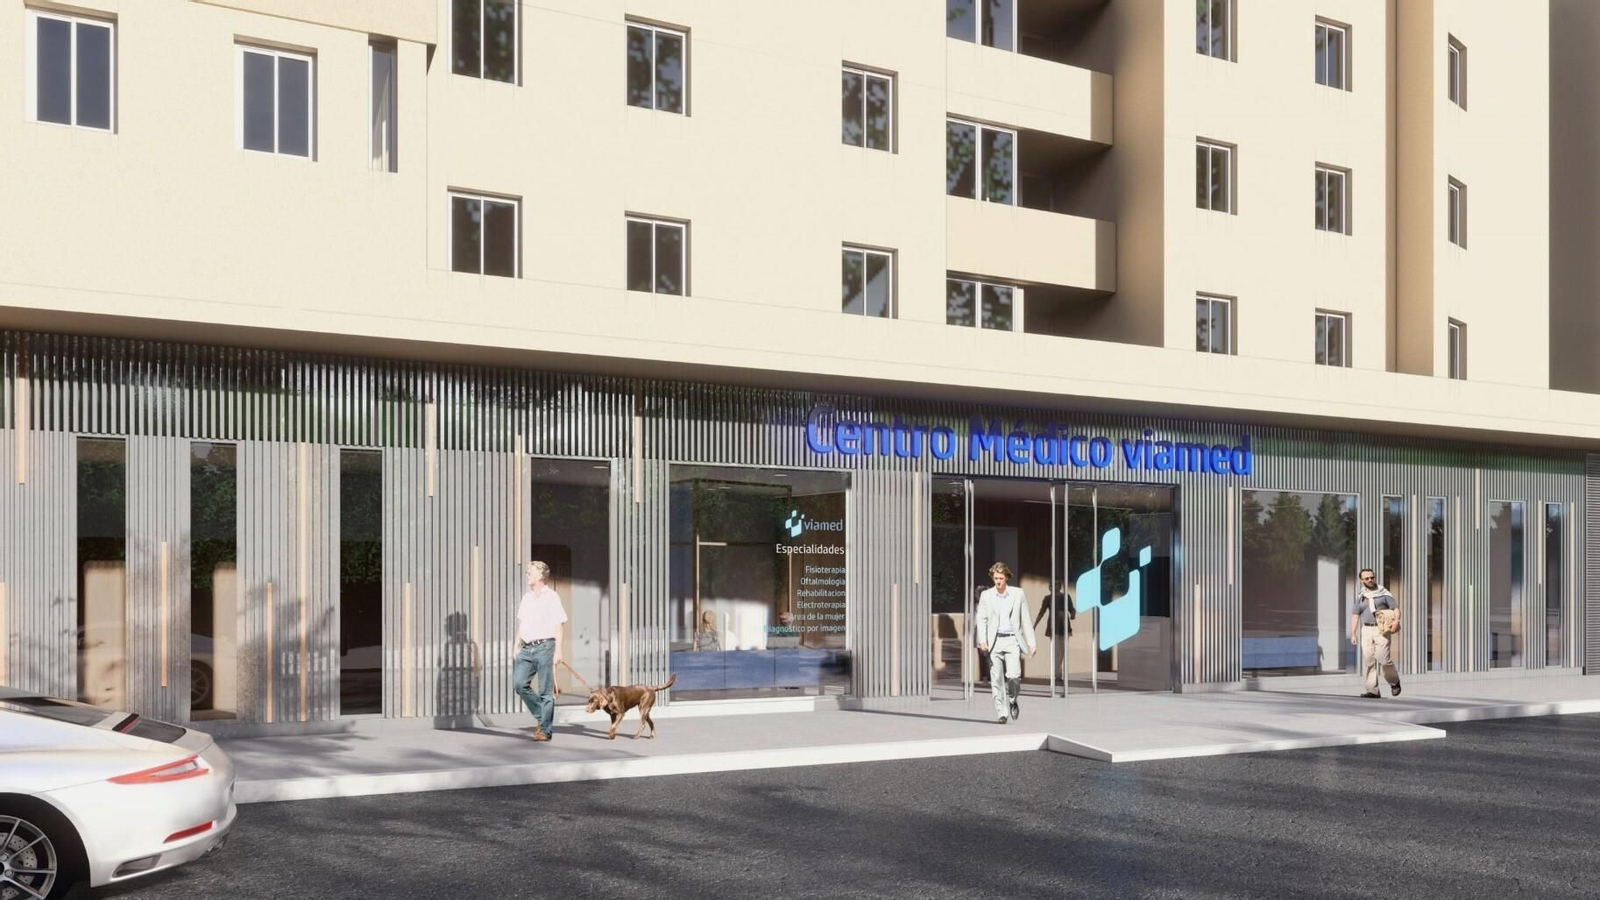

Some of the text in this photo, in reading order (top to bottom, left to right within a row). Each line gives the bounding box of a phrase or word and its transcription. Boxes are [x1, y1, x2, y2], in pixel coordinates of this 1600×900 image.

[806, 406, 1251, 475] Centro Médico viamed
[804, 519, 843, 531] viamed
[775, 543, 845, 555] Especialidades
[805, 565, 846, 575] Fisioterapia
[797, 600, 846, 609] Electroterapia
[807, 612, 816, 621] de
[817, 612, 824, 620] la
[824, 612, 845, 622] mujer
[807, 625, 819, 633] por
[820, 624, 846, 633] imagen
